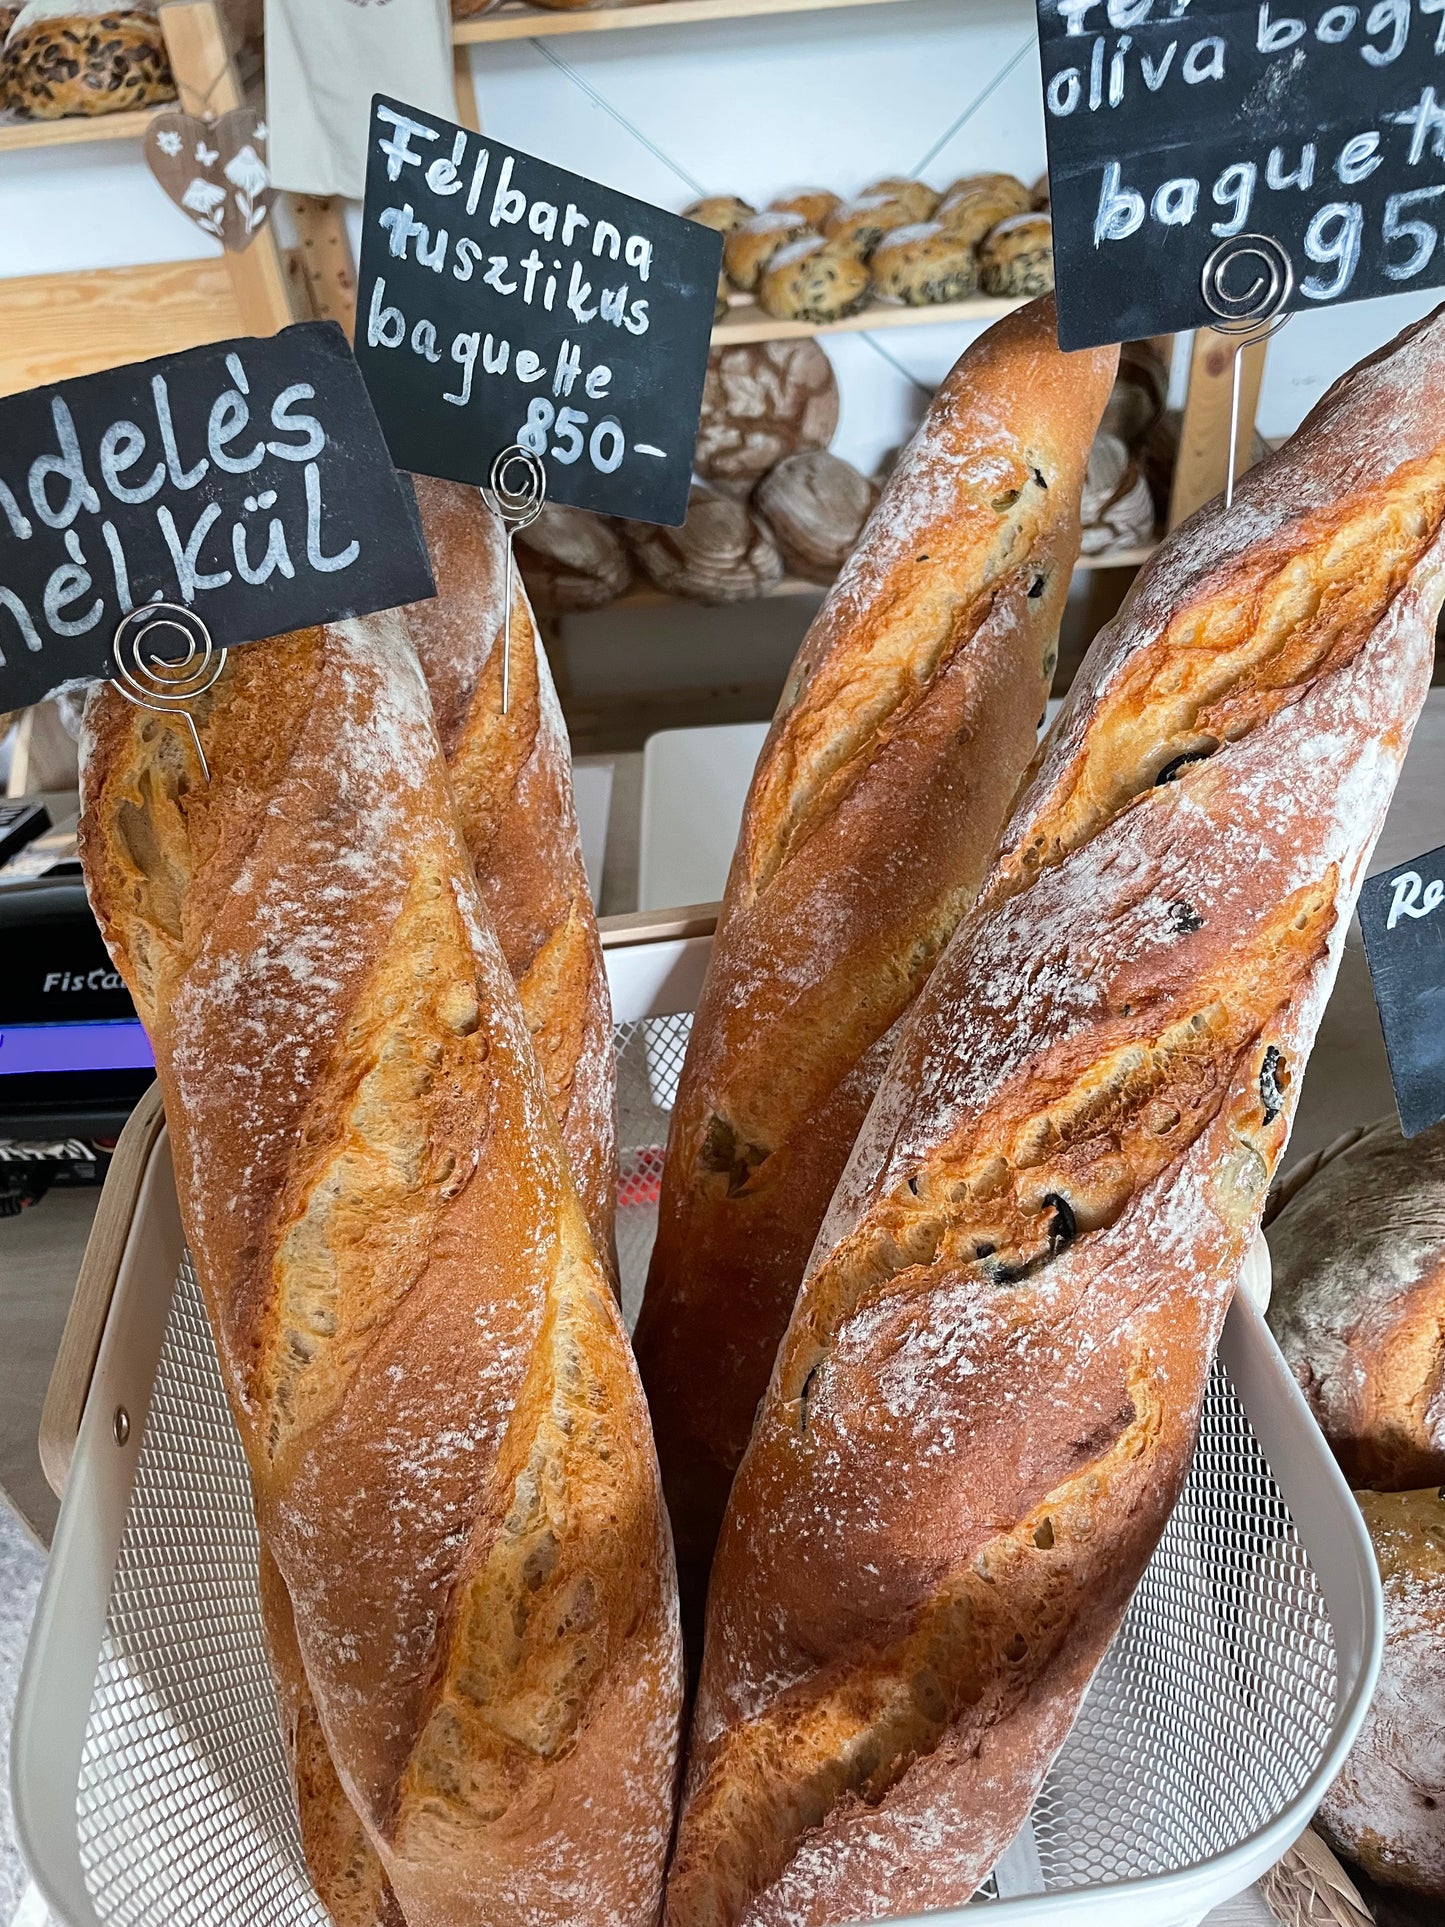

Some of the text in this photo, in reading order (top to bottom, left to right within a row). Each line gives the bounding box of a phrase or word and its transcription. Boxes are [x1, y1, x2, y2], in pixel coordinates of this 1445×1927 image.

[1047, 34, 1227, 117] oliva
[1299, 184, 1445, 300] 95
[367, 276, 614, 406] baguette
